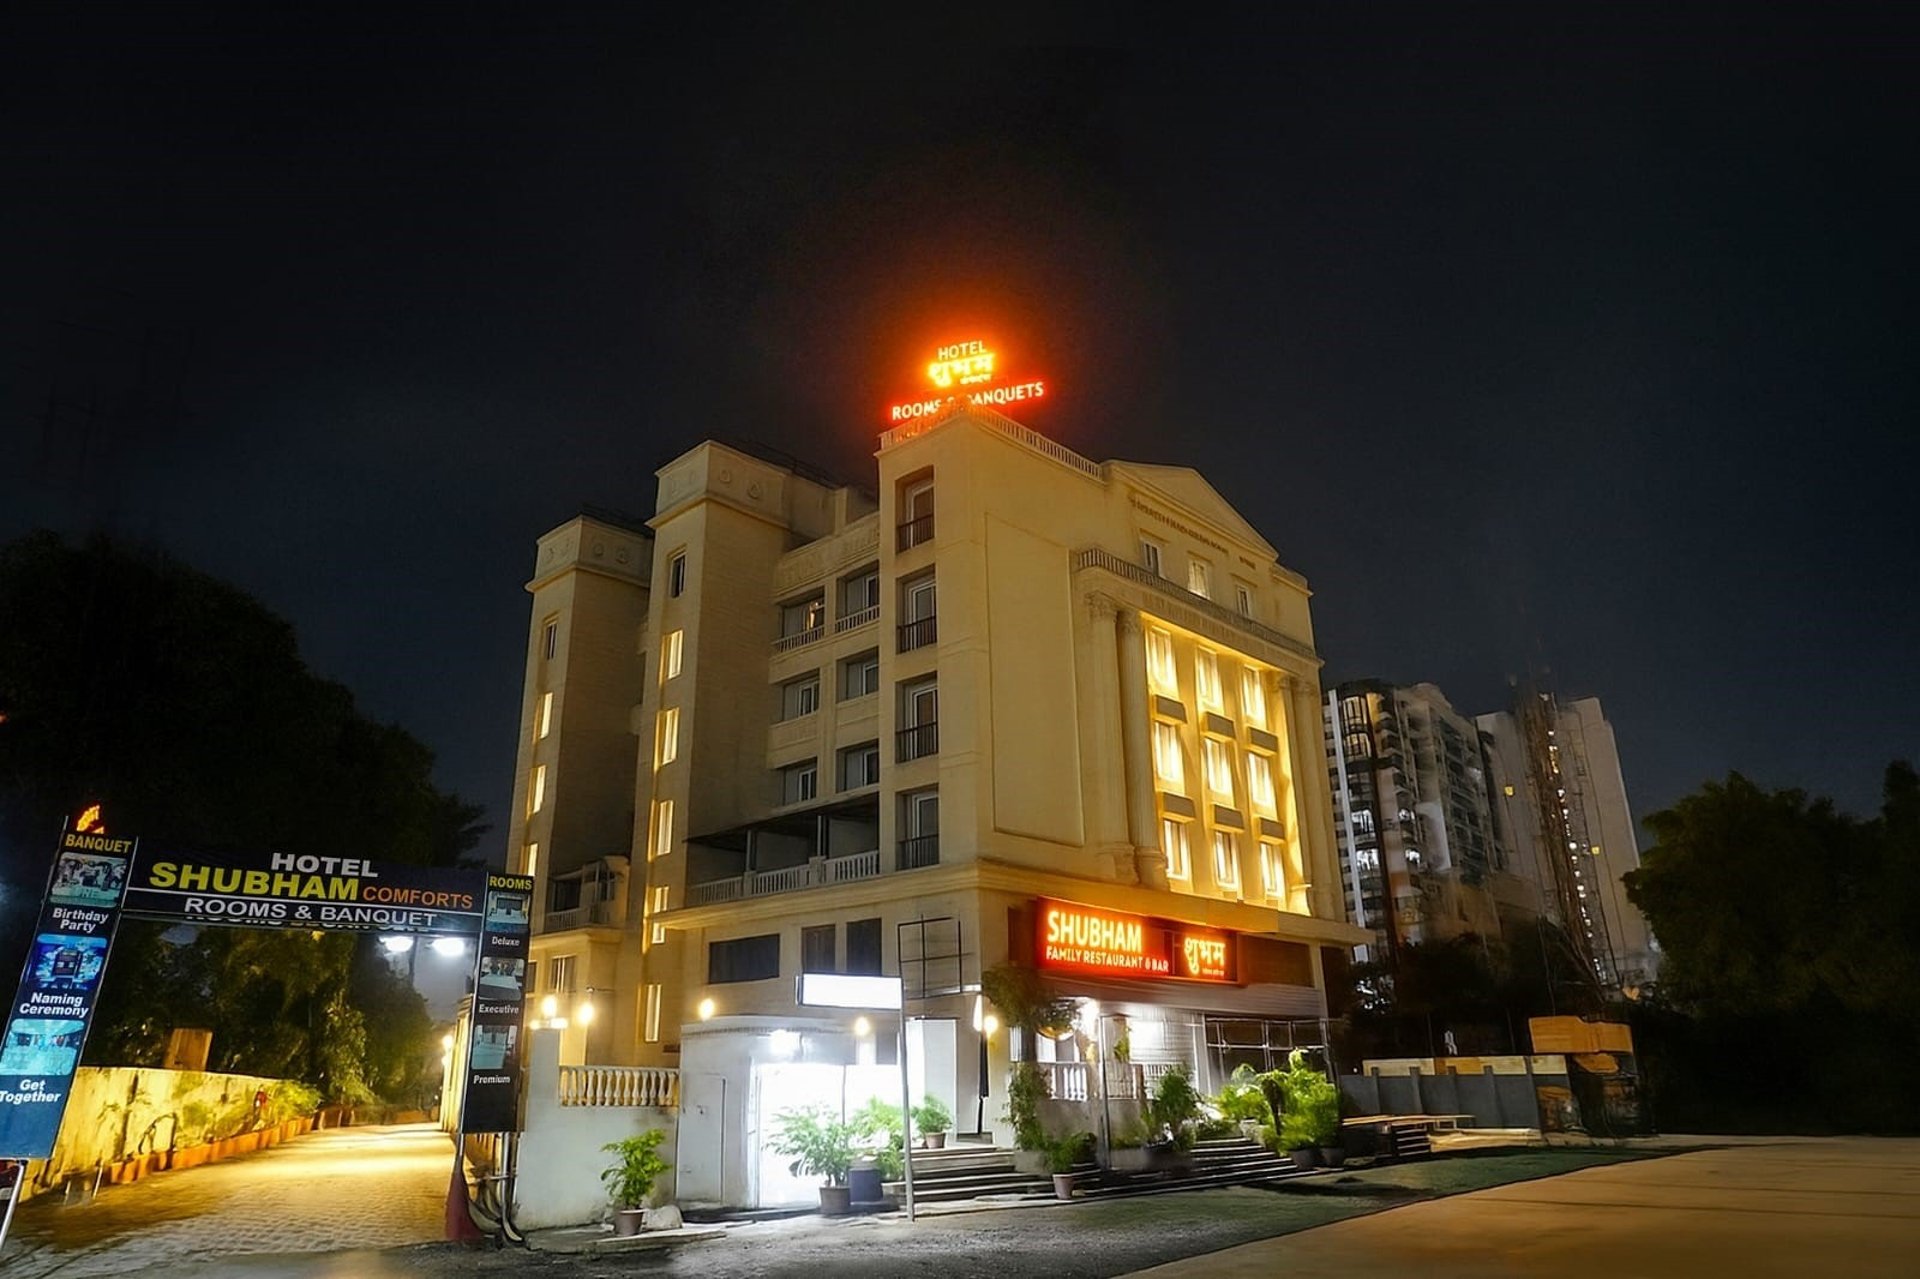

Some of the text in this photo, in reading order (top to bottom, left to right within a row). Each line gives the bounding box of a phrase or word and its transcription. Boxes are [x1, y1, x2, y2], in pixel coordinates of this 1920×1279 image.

[938, 340, 988, 361] HOTEL
[65, 834, 132, 853] BANQUET
[271, 852, 379, 878] HOTEL
[150, 862, 474, 909] SHUBHAM COMFORTS
[489, 876, 533, 890] ROOMS
[52, 908, 109, 924] Birthday
[184, 897, 288, 920] ROOMS
[294, 904, 313, 920] &
[319, 906, 438, 928] BANQUET
[60, 918, 97, 934] Party
[1047, 911, 1142, 952] SHUBHAM
[492, 936, 521, 946] Deluxe
[1046, 946, 1082, 962] FAMILY
[1084, 951, 1143, 968] RESTAURANT
[1152, 960, 1169, 972] BAR
[1184, 936, 1226, 974] शुभम
[31, 992, 84, 1007] Naming
[19, 1003, 90, 1018] Ceremony
[479, 1004, 520, 1014] Executive
[19, 1079, 46, 1091] Get
[473, 1075, 511, 1085] Premium
[0, 1090, 61, 1104] Together
